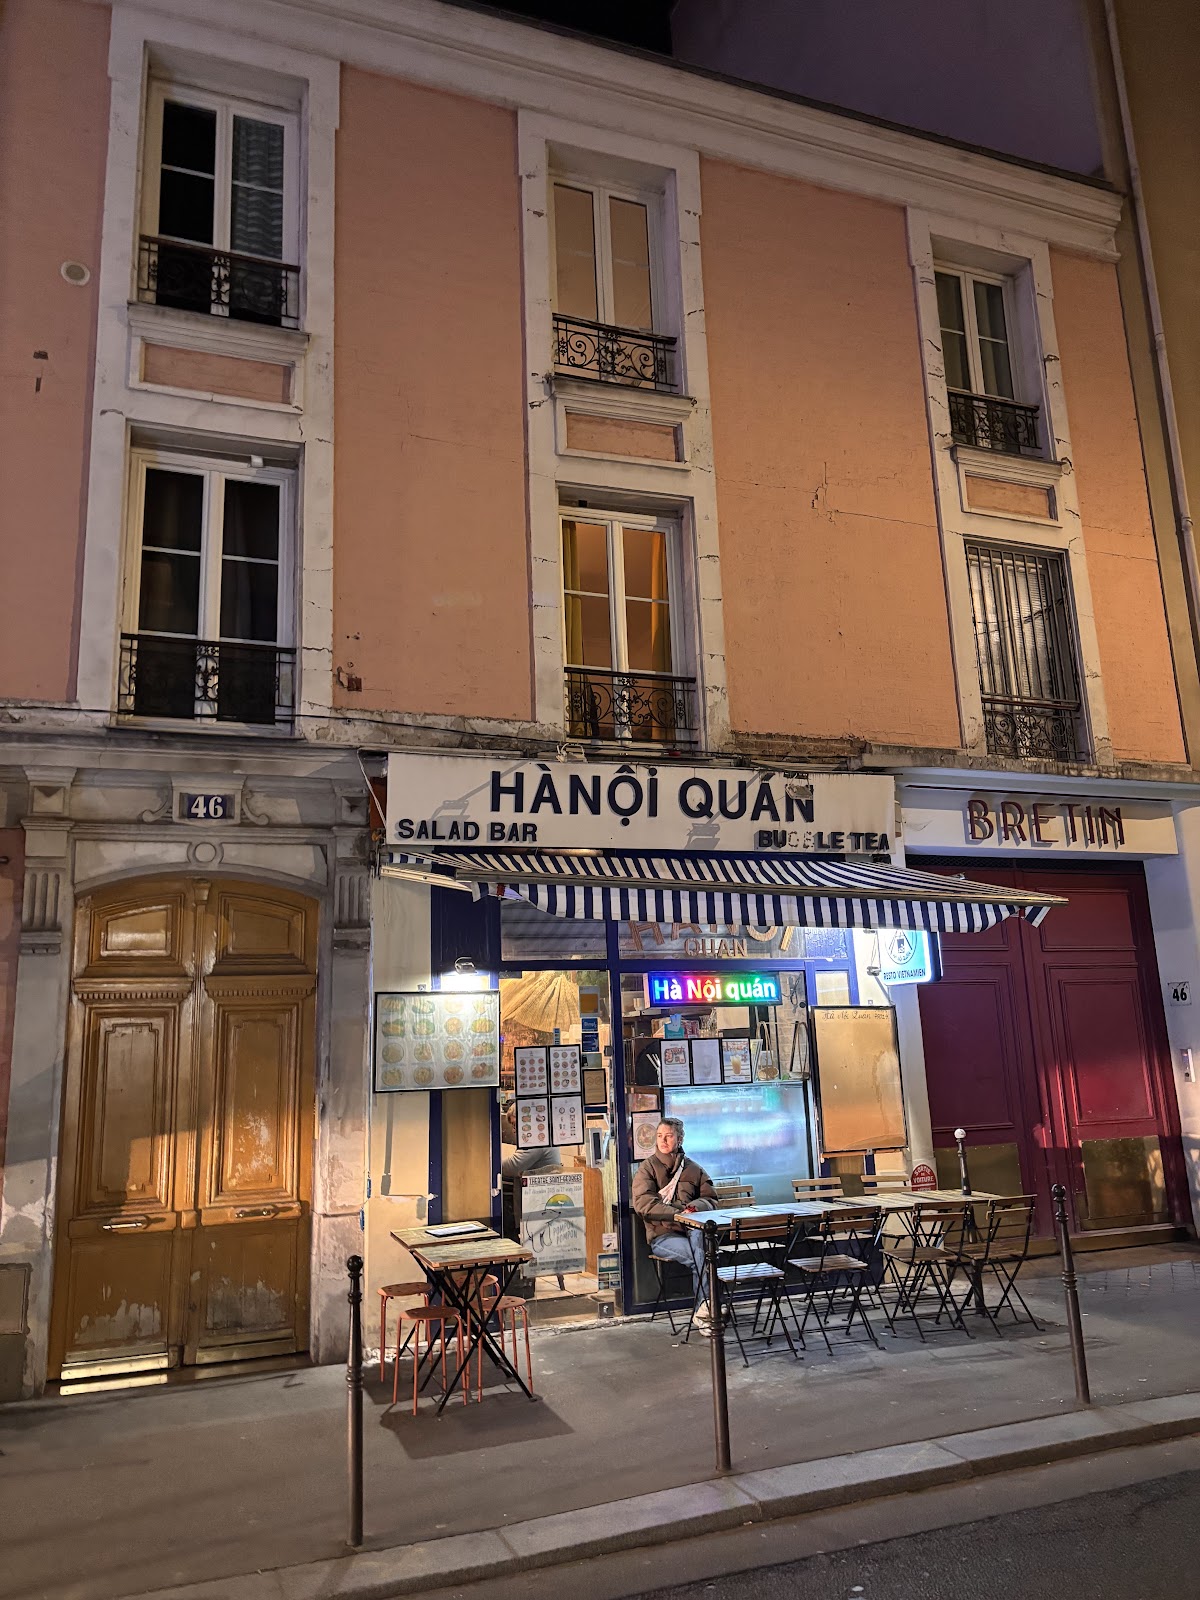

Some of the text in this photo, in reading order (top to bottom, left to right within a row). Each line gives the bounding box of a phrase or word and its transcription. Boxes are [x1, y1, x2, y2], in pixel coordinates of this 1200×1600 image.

[191, 795, 224, 819] 46
[679, 772, 815, 823] QUÁN
[398, 818, 538, 842] SALAD BAR
[968, 799, 1125, 846] BRETIN
[758, 829, 890, 851] BULE TEA
[684, 937, 749, 957] QUAN
[883, 968, 926, 980] RESTO VIETNAMIEN
[653, 977, 777, 1002] Hà Nội quán
[1172, 987, 1188, 1002] 46
[914, 1166, 931, 1176] SORTIE
